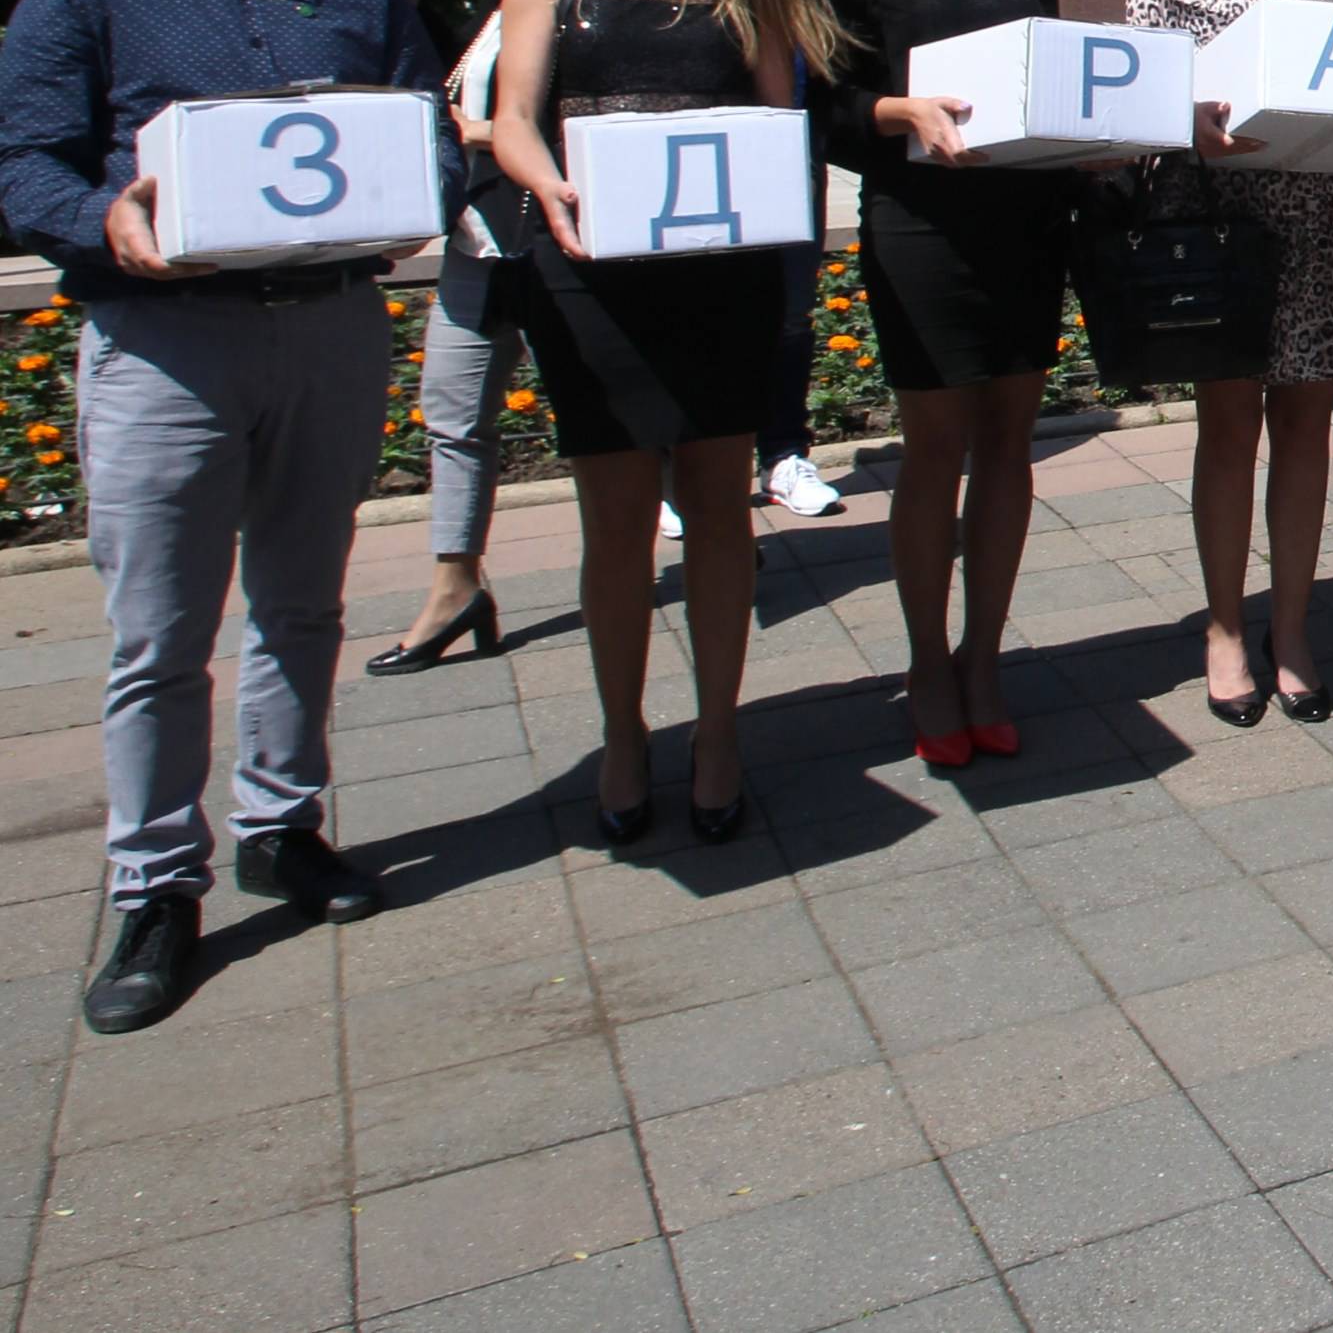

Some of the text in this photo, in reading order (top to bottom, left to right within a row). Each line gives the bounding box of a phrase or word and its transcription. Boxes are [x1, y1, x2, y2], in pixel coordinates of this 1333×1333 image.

[1080, 36, 1140, 119] Р
[256, 111, 346, 218] З
[648, 133, 741, 251] Д
